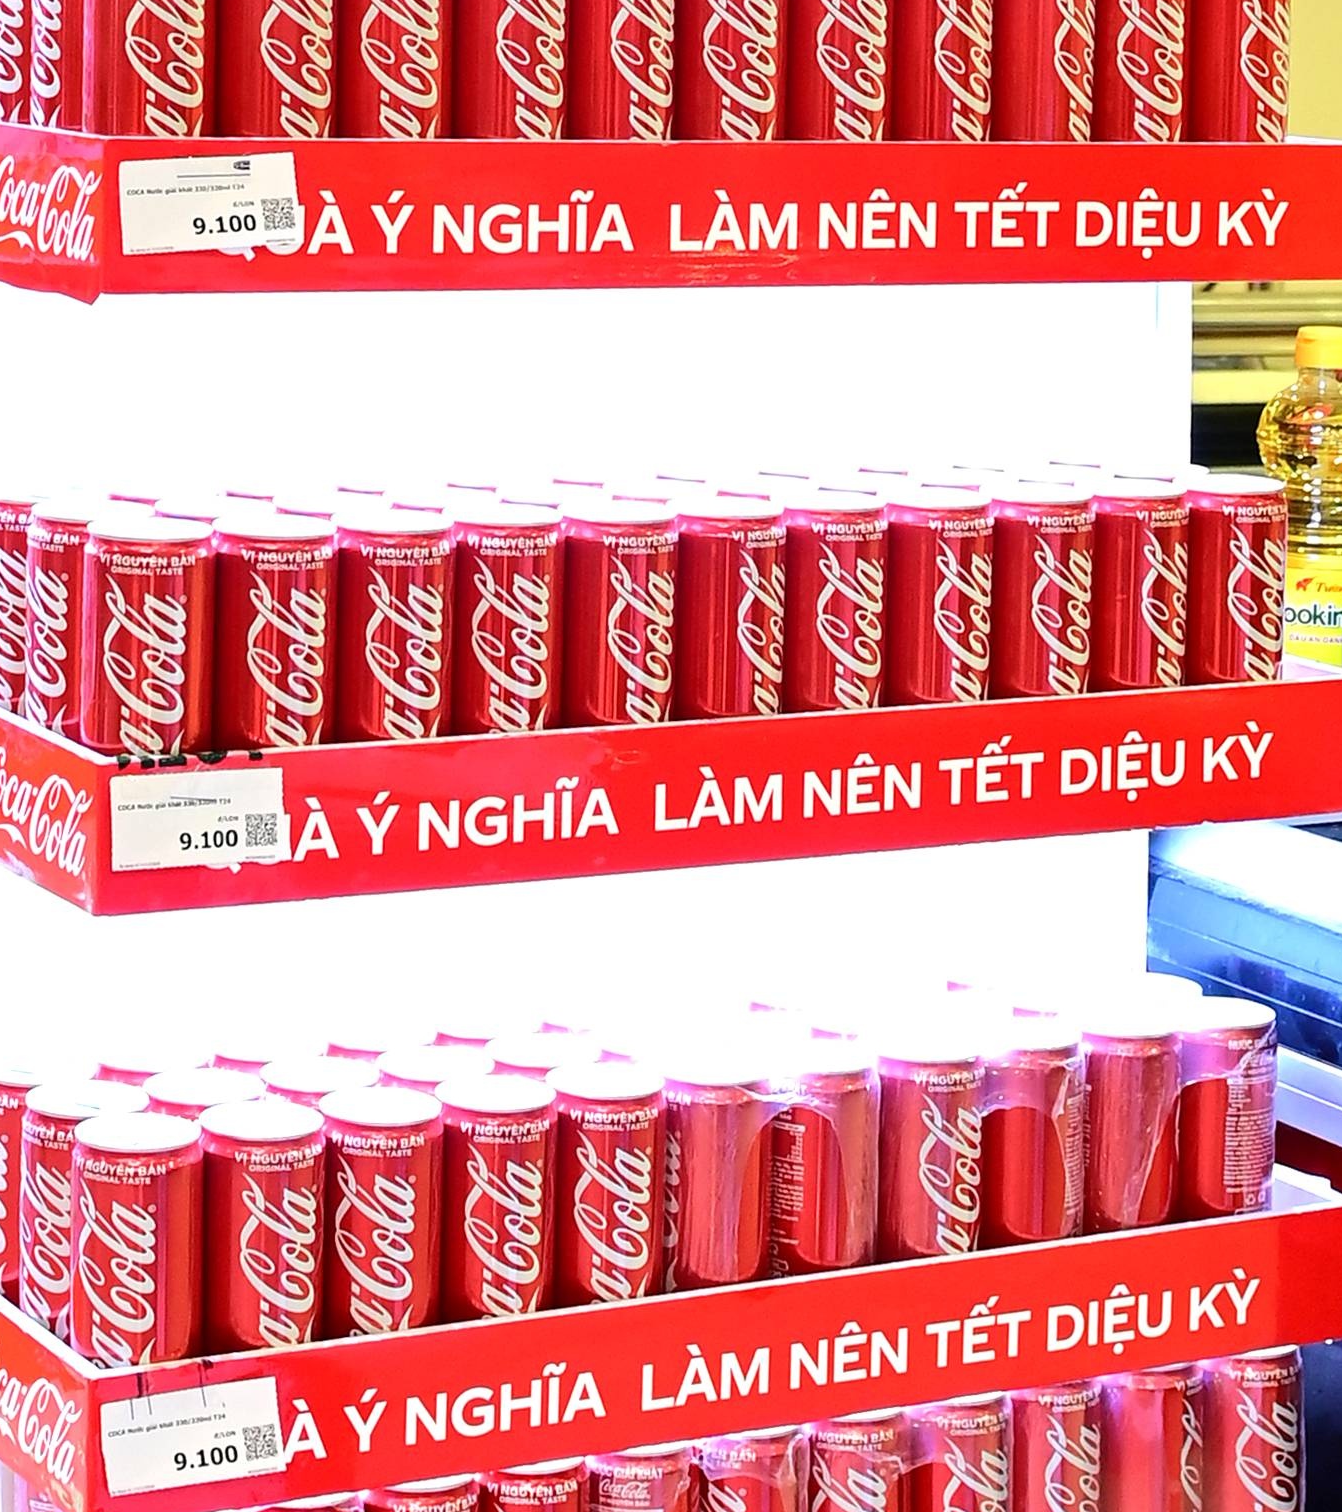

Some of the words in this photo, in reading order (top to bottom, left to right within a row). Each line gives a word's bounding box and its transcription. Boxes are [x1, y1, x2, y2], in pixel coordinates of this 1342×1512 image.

[193, 214, 256, 235] 9.100
[371, 191, 419, 254] Ý
[434, 191, 635, 254] NGHĨA
[670, 190, 799, 252] LÀM
[818, 188, 938, 250] NÊN
[954, 182, 1059, 250] TẾT
[1075, 188, 1201, 259] DIỆU
[1218, 188, 1291, 247] KỲ
[356, 790, 405, 856] Ý
[417, 777, 620, 852] NGHĨA
[654, 767, 784, 832] LÀM
[802, 754, 922, 818] NÊN
[939, 735, 1045, 805] TẾT
[1059, 731, 1187, 801] DIỆU
[1201, 721, 1274, 783] KỲ
[179, 830, 238, 850] 9.100
[345, 1387, 395, 1454] Ý
[406, 1361, 606, 1445] NGHĨA
[640, 1343, 770, 1412] LÀM
[790, 1320, 909, 1390] NÊN
[925, 1295, 1032, 1369] TẾT
[1045, 1293, 1172, 1355] DIỆU
[1188, 1267, 1262, 1329] KỲ
[174, 1445, 238, 1471] 9.100
